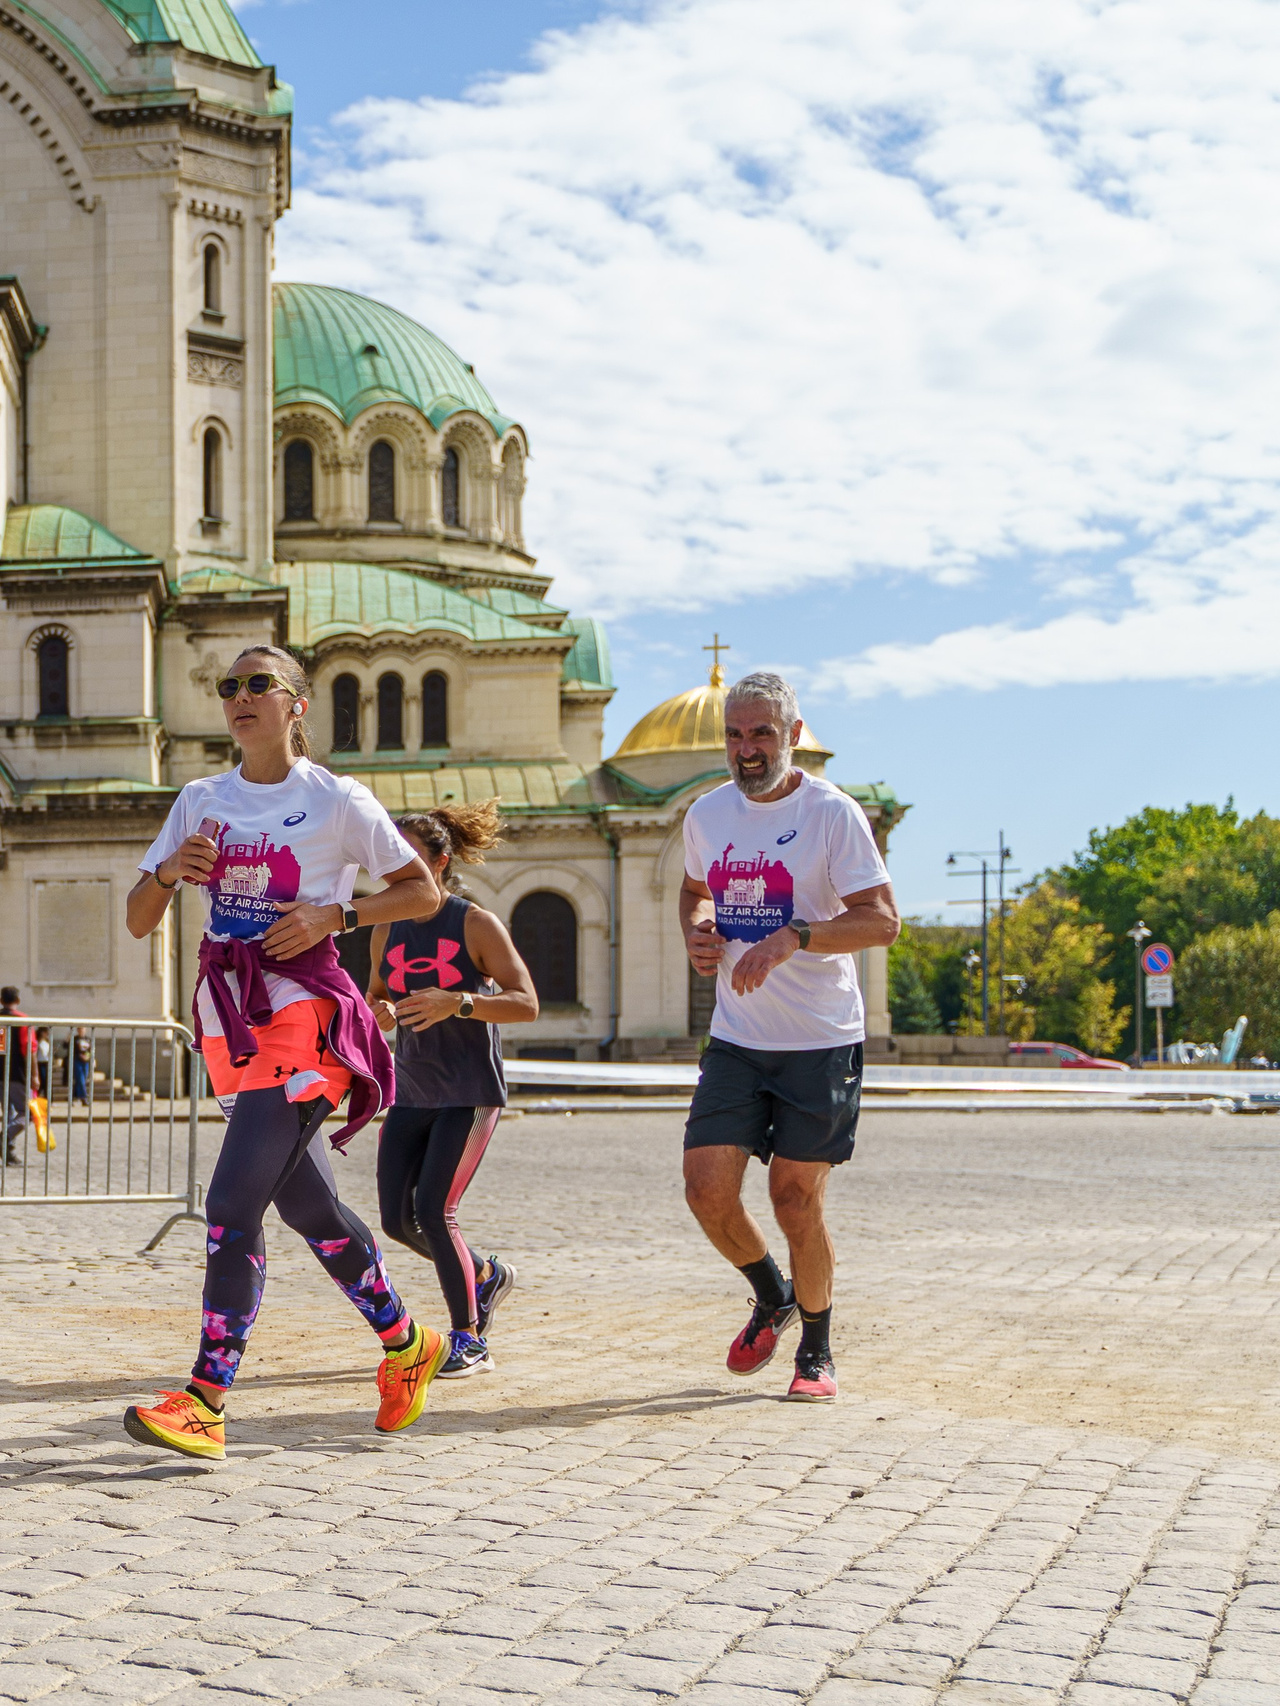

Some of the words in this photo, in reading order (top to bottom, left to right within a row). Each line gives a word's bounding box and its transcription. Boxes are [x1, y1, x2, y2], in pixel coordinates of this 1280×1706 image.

[235, 897, 251, 909] AIR
[736, 908, 751, 916] AIR
[753, 908, 783, 917] SOFIA
[253, 912, 279, 924] 2023
[760, 918, 783, 927] 2023
